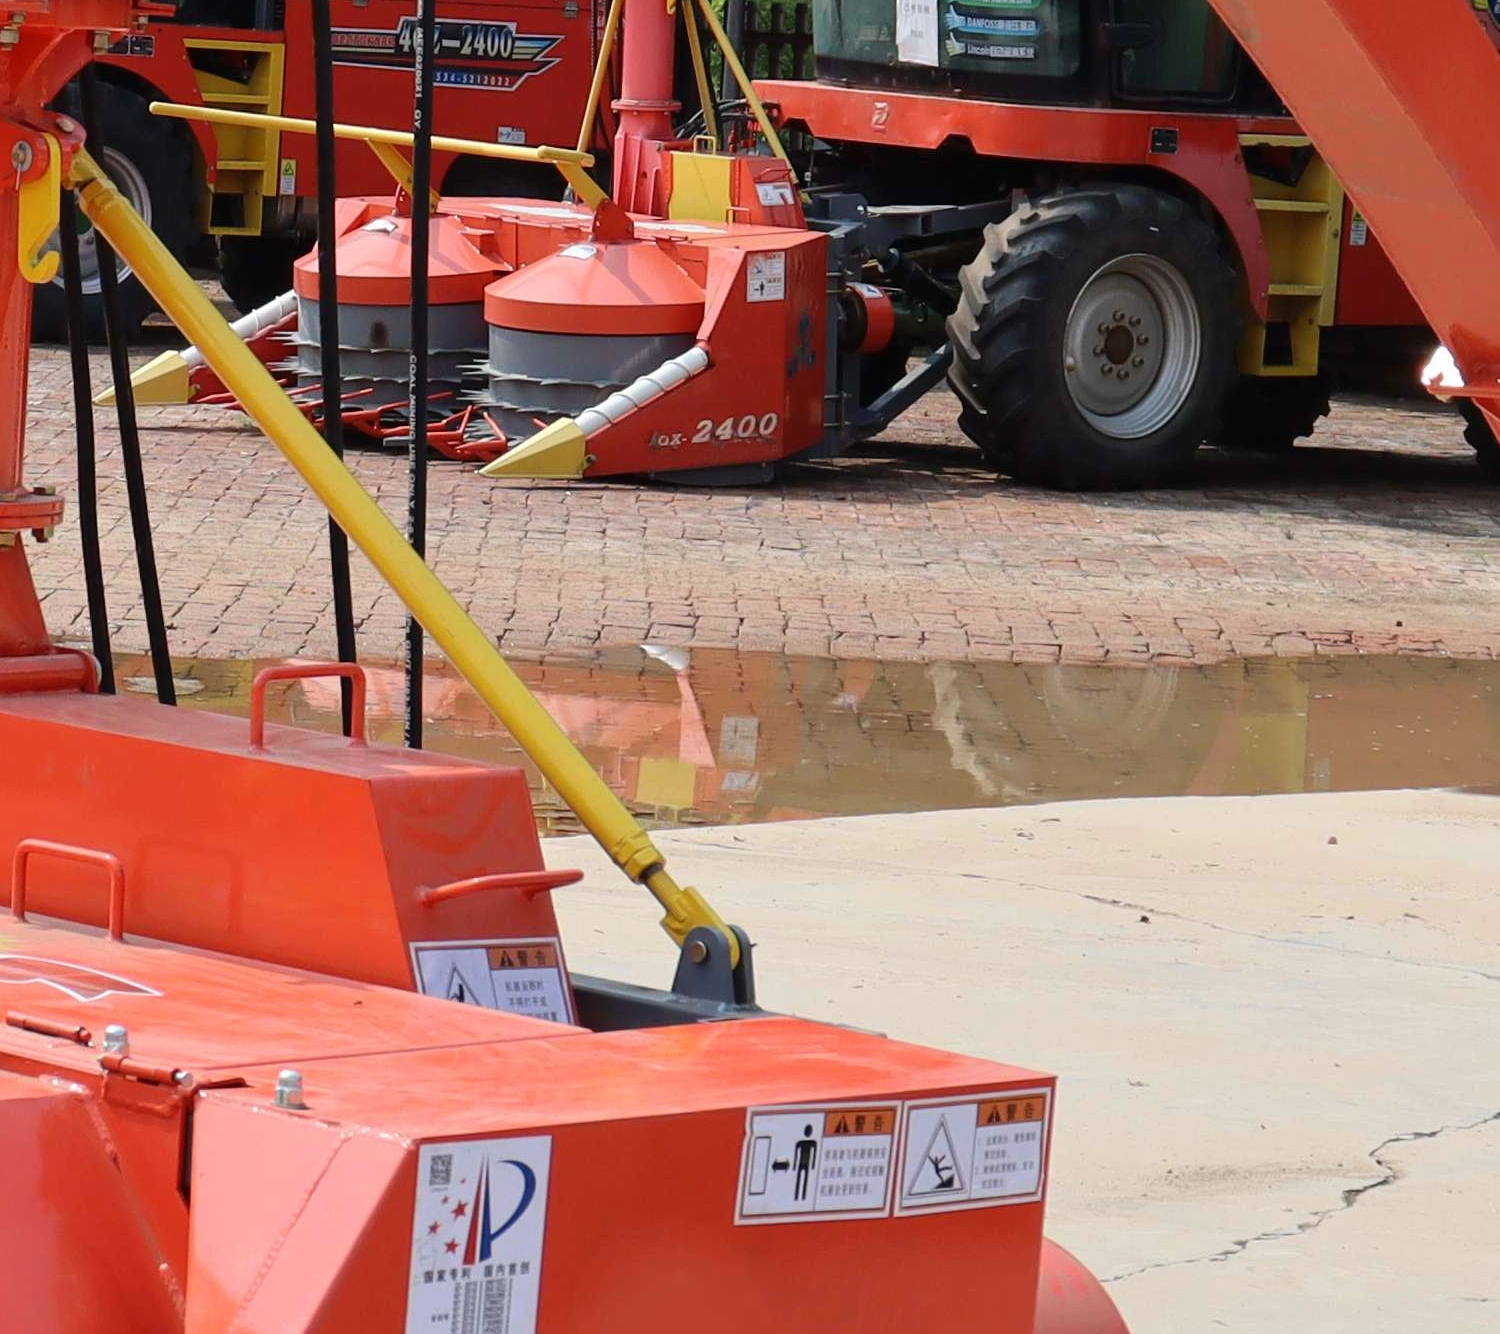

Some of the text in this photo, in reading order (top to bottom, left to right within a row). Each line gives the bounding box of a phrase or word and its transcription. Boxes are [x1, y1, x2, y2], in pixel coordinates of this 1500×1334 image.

[409, 354, 418, 392] COAL
[408, 394, 417, 441] MINING
[408, 443, 417, 469] USE
[408, 473, 417, 509] ONLY
[854, 1114, 885, 1134] 警告
[1006, 1102, 1037, 1121] 警告
[423, 1261, 530, 1284] 国家专利 国内首创
